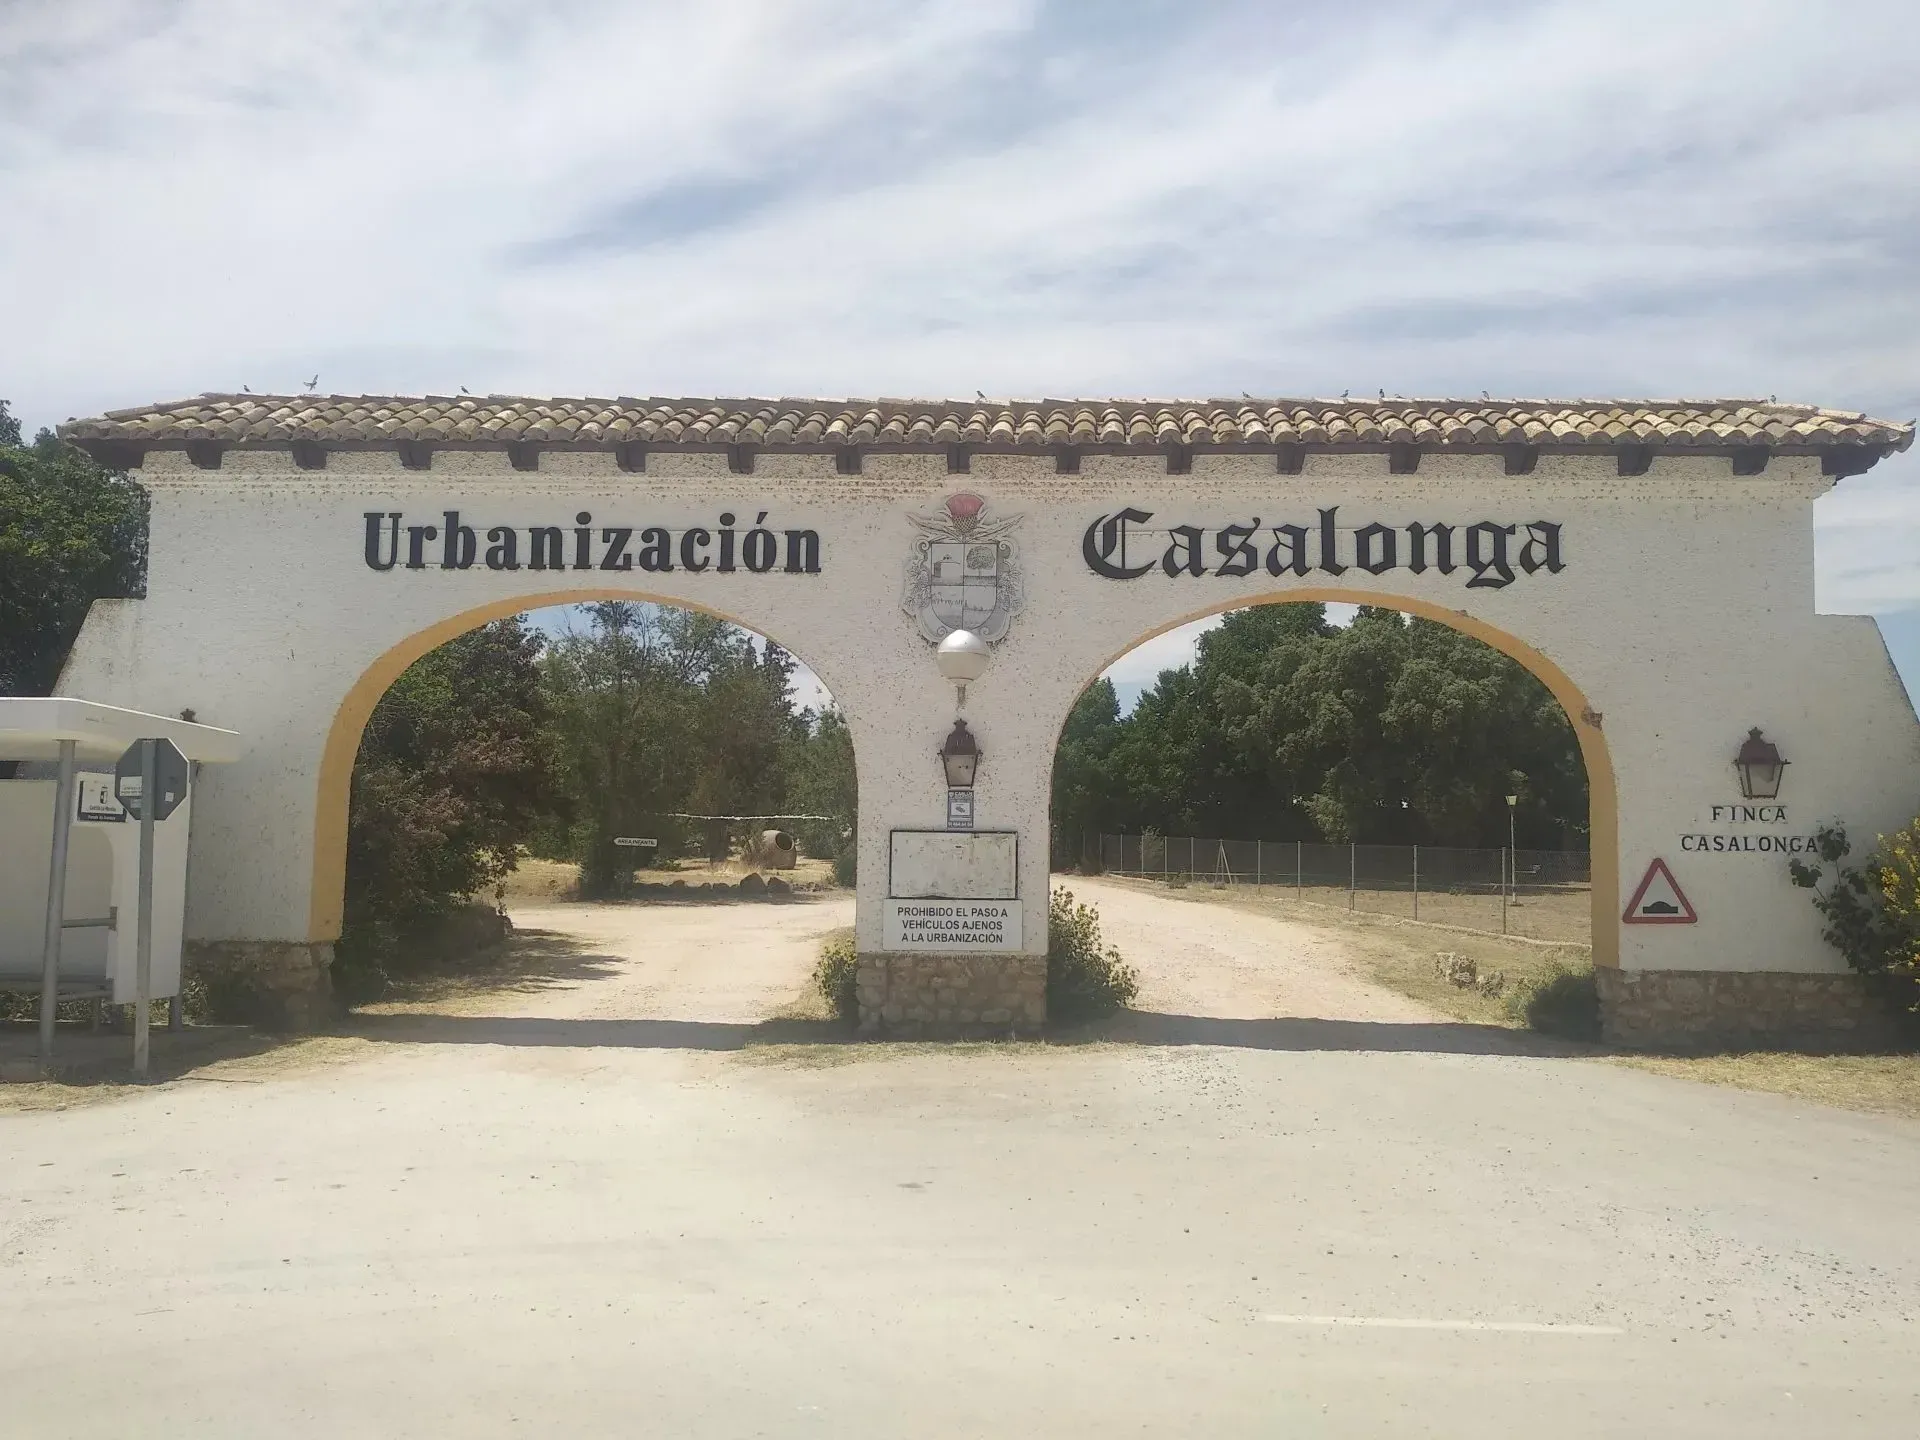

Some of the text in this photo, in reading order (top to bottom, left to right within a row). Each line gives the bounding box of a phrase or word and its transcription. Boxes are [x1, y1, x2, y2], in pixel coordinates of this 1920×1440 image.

[363, 506, 1568, 588] Urbanización Casalonga
[1711, 805, 1787, 822] FINCA
[1680, 835, 1818, 852] CASALONGA
[897, 907, 1008, 918] PROHIBIDO EL PASO A
[902, 918, 1003, 931] VEHÍCULOS AJENOS
[901, 931, 1003, 943] A LA URBANIZACIÓN
